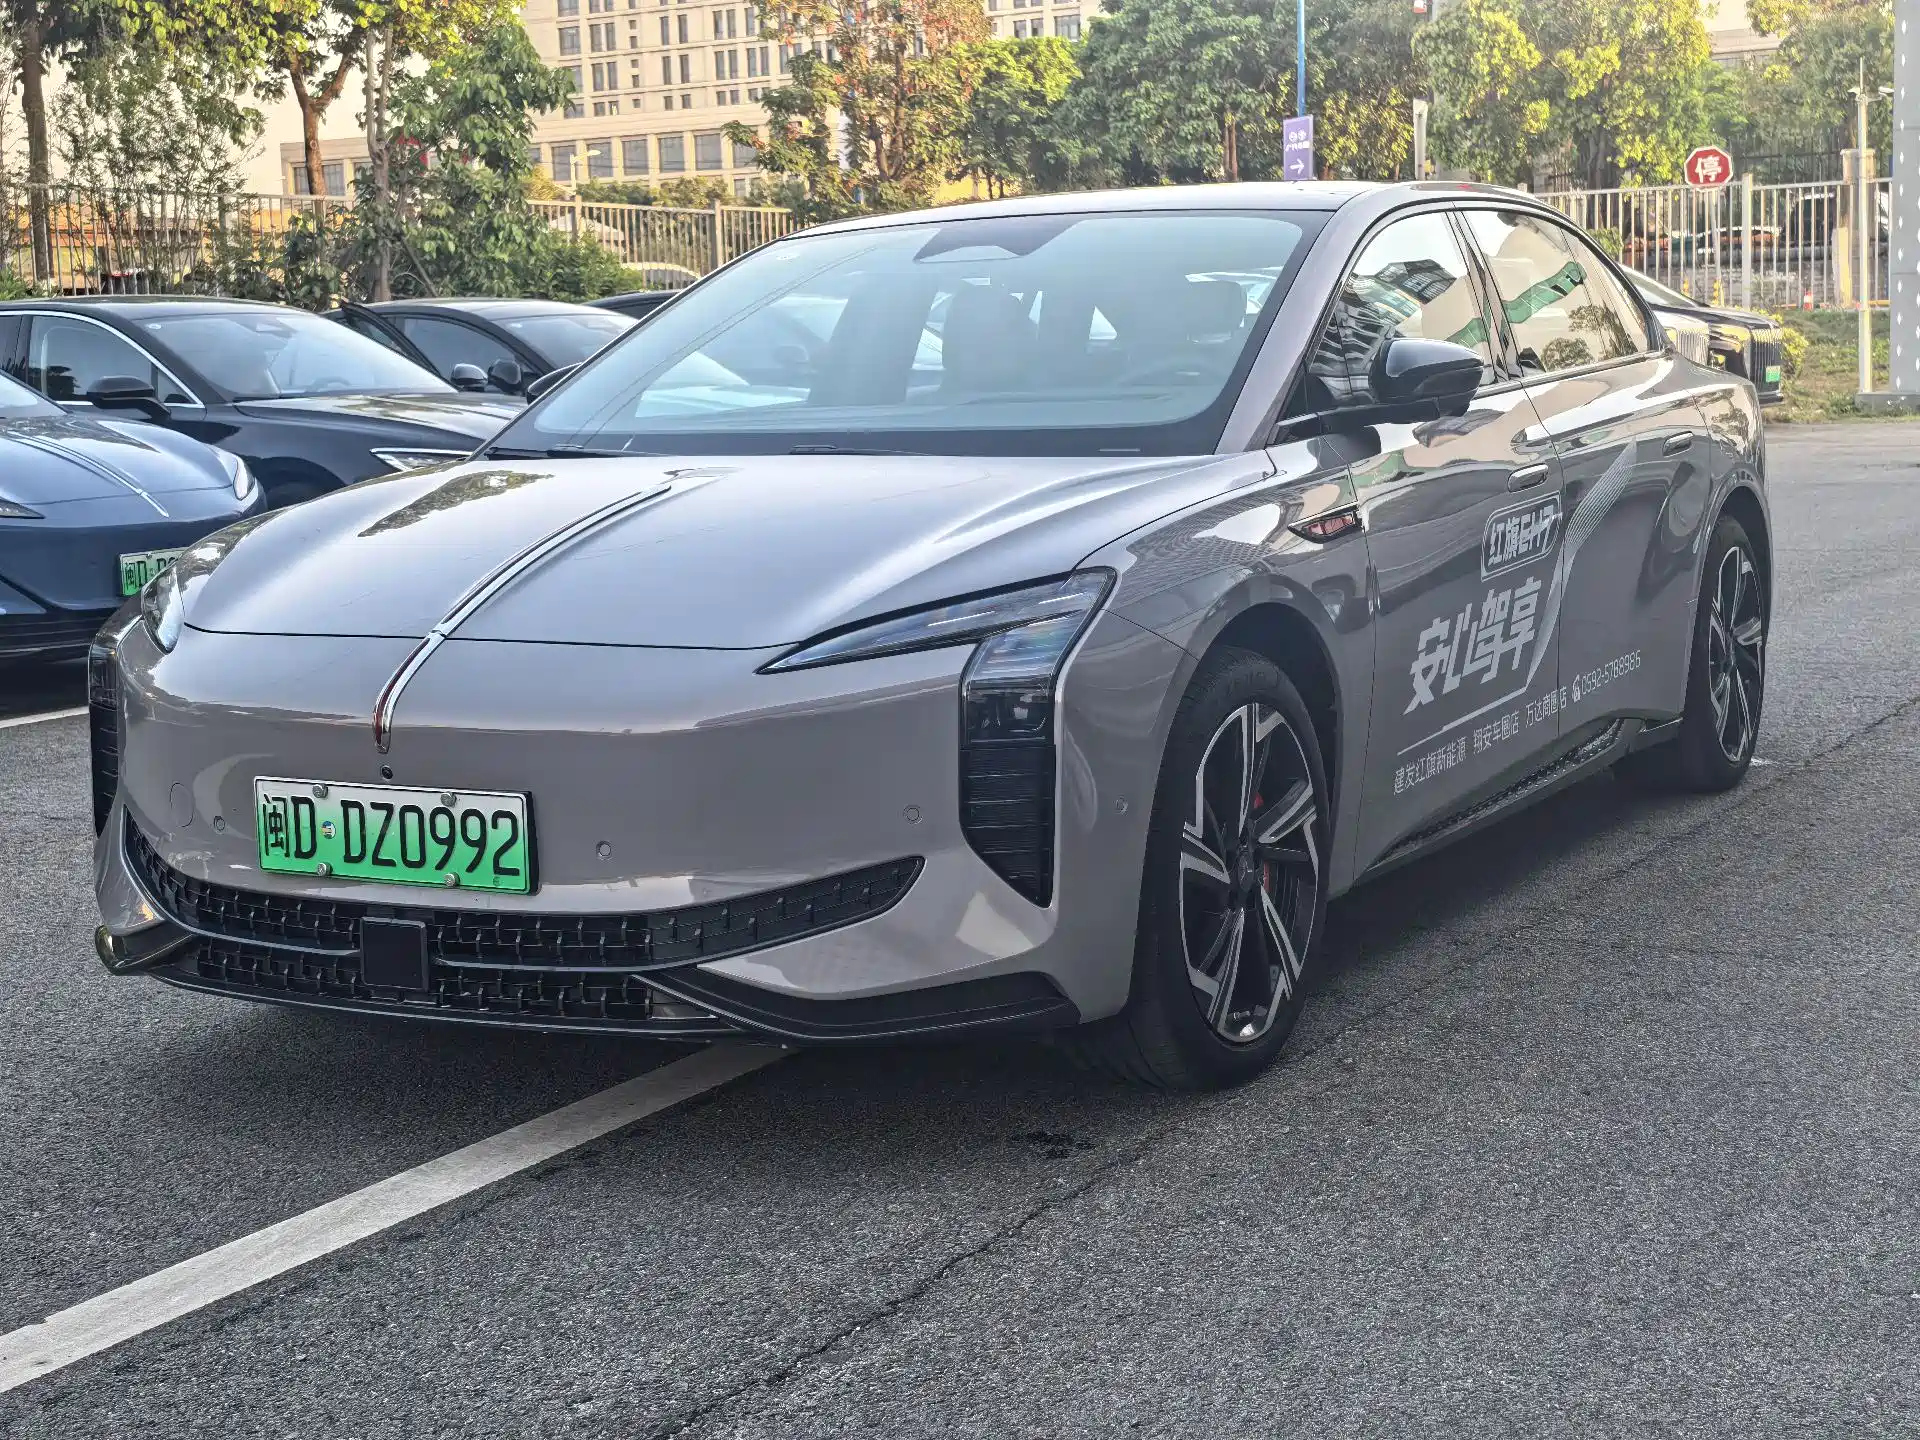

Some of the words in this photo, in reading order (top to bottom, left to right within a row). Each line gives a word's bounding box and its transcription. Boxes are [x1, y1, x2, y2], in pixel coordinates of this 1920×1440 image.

[1695, 155, 1722, 183] 停
[1402, 576, 1542, 716] 安心驾享
